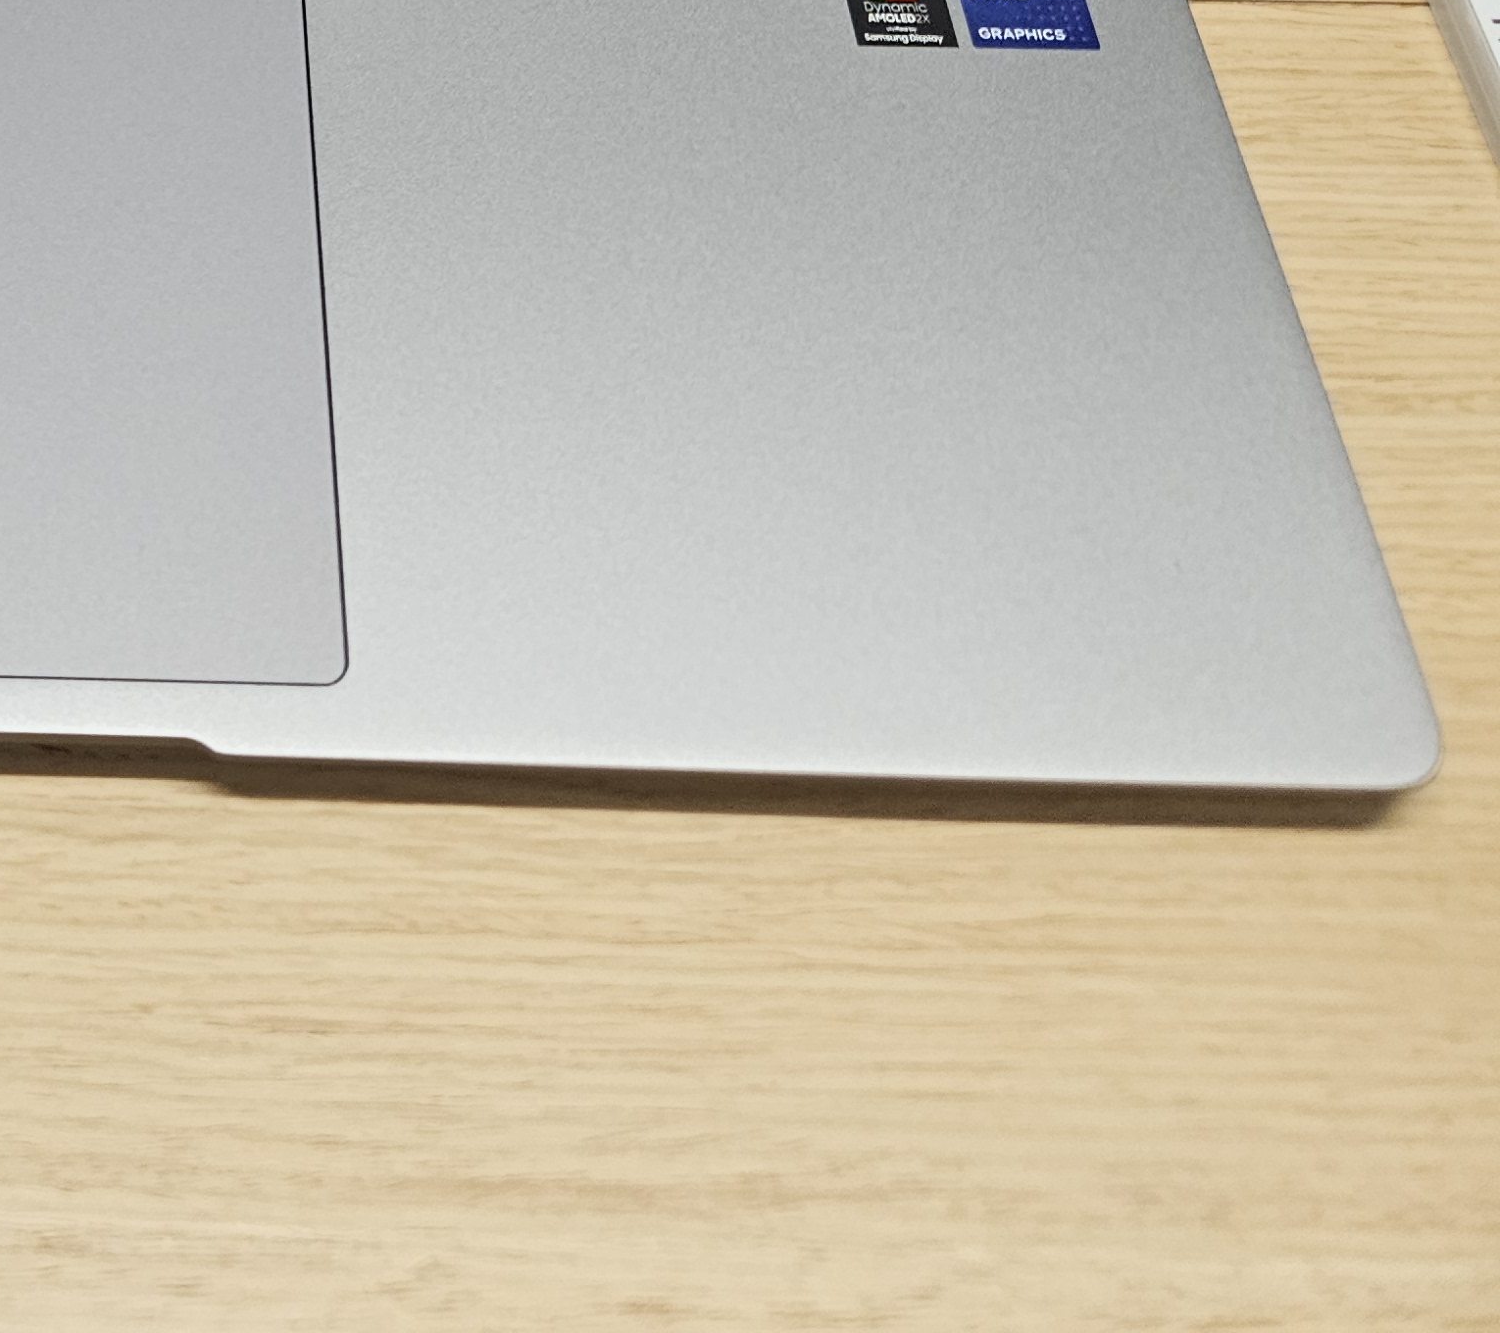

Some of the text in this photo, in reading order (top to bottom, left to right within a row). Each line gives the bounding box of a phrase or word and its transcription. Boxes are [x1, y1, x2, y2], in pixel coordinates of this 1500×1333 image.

[864, 2, 928, 13] Dynamic
[864, 33, 944, 45] Samsung Display
[978, 27, 1066, 41] GRAPHICS
